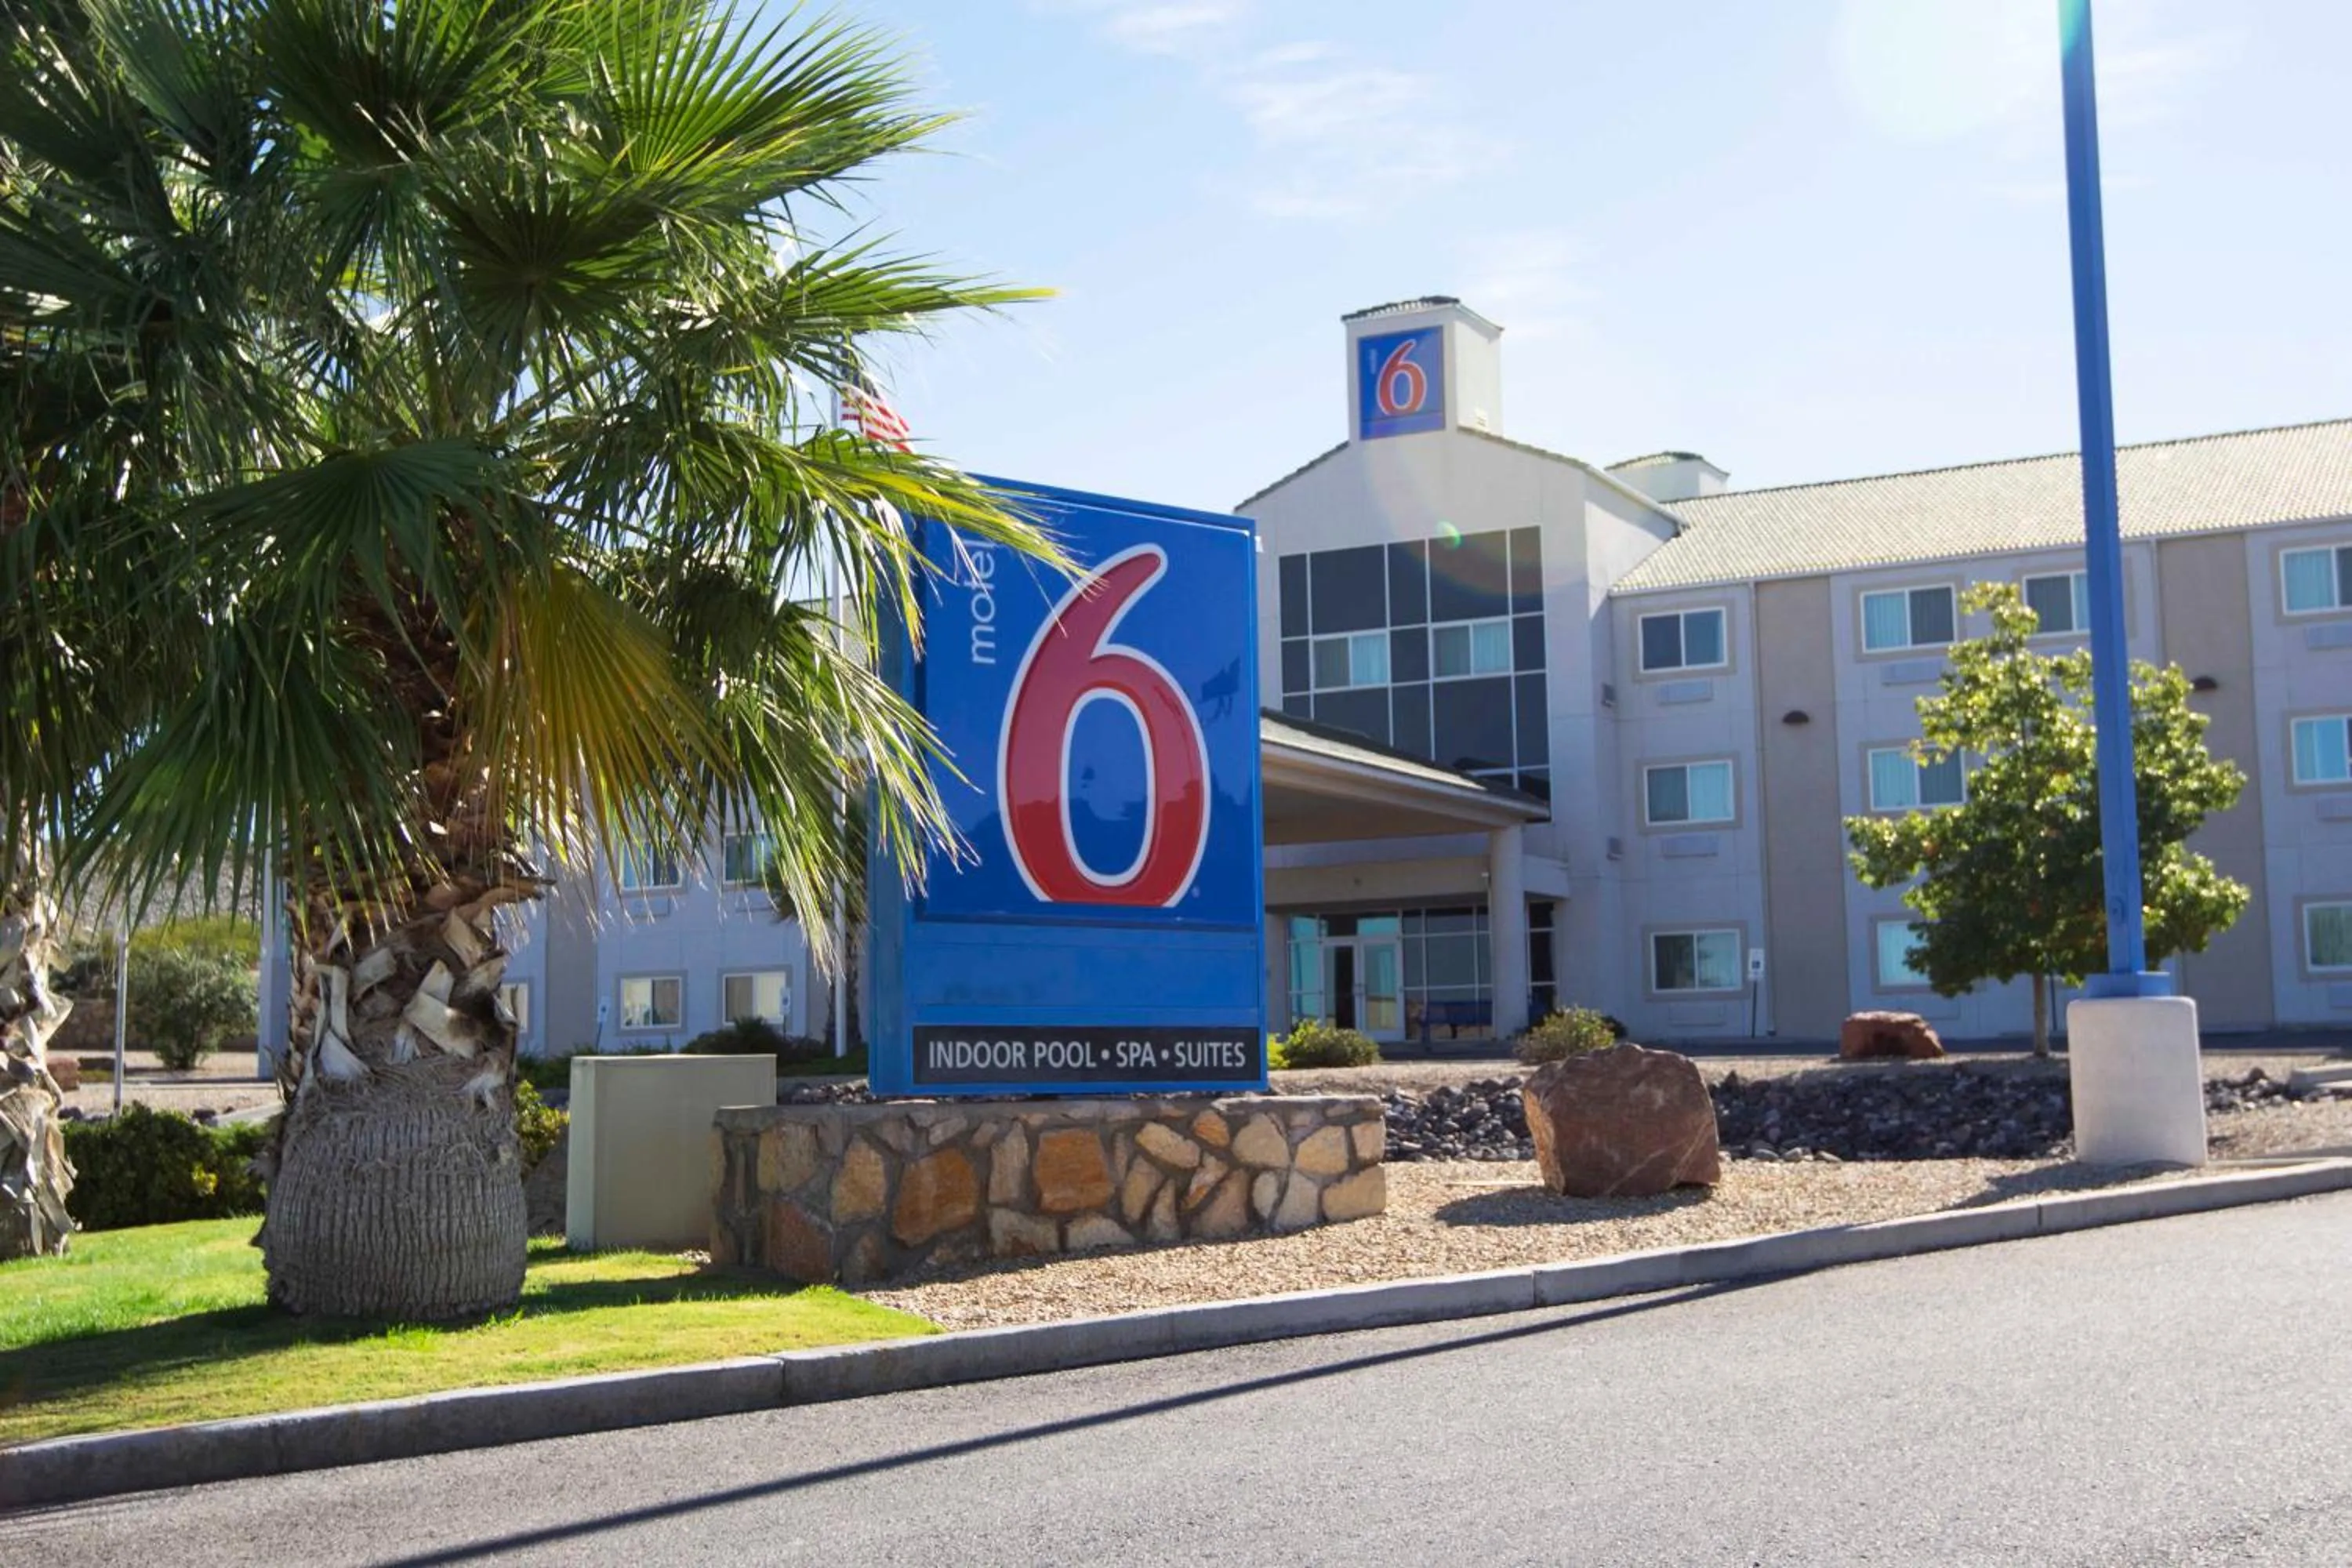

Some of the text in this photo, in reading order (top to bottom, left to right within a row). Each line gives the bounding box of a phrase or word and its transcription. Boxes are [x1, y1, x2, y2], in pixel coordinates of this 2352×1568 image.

[1376, 338, 1427, 416] 6
[963, 538, 996, 665] motel
[996, 543, 1211, 908] 6
[928, 1040, 1247, 1069] INDOOR POOL SPA SUITES
